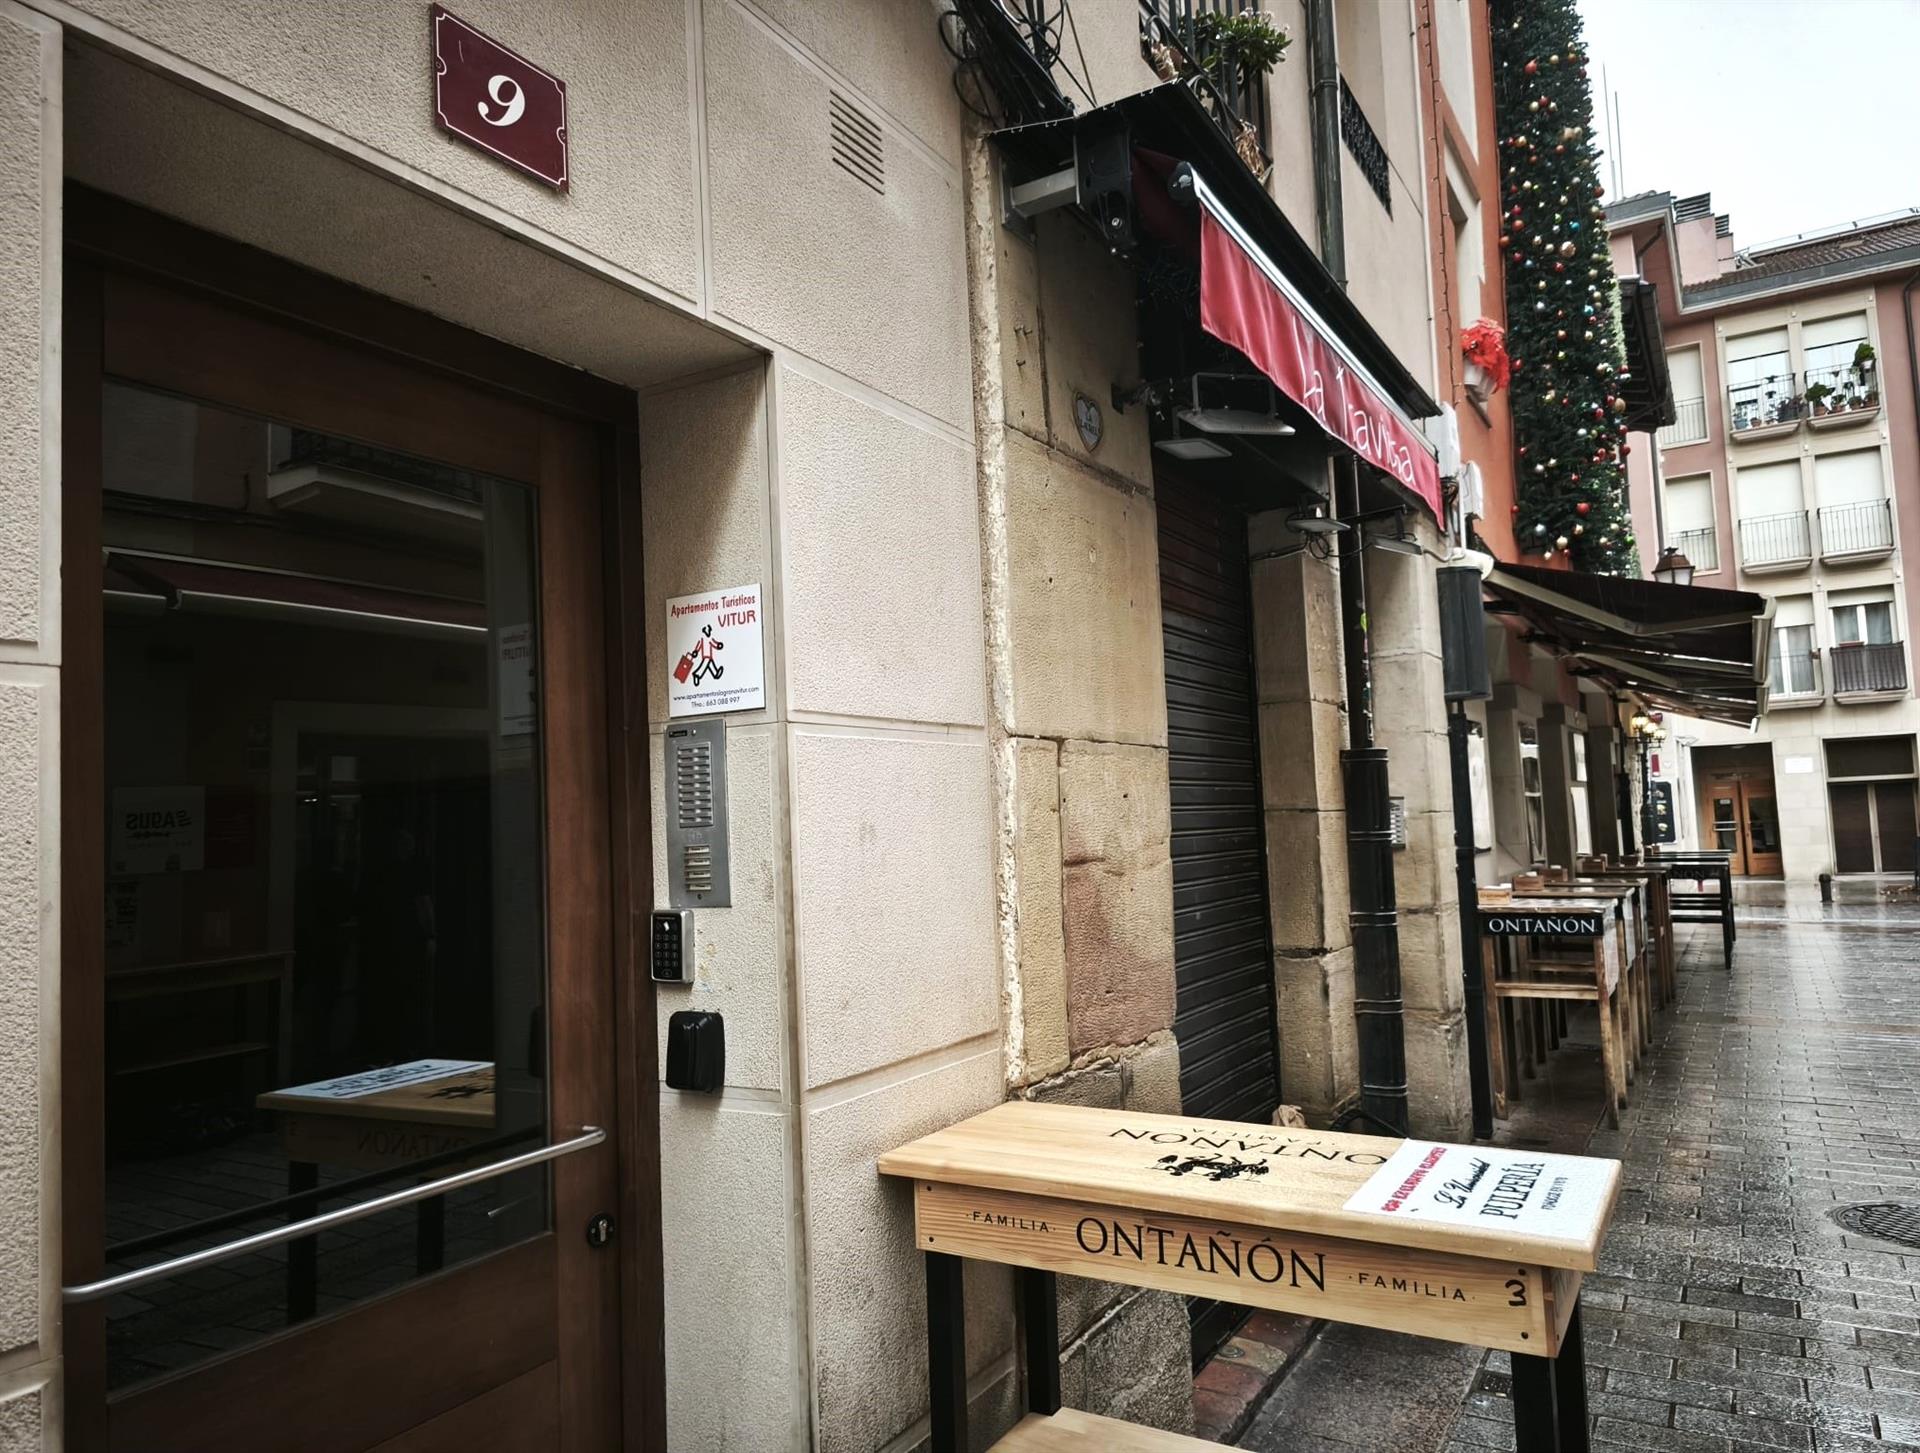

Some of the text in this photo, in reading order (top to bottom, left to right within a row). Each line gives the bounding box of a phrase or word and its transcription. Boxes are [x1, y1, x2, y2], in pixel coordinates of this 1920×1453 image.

[478, 75, 525, 126] 9
[1292, 314, 1327, 422] La
[671, 600, 719, 619] Apartamentos
[718, 610, 756, 627] VITUR
[1489, 916, 1595, 933] ONTAÑÓN
[1479, 1162, 1546, 1220] PULPERÍA
[1076, 1217, 1326, 1292] ONTAÑÓN
[1505, 1279, 1526, 1306] 3
